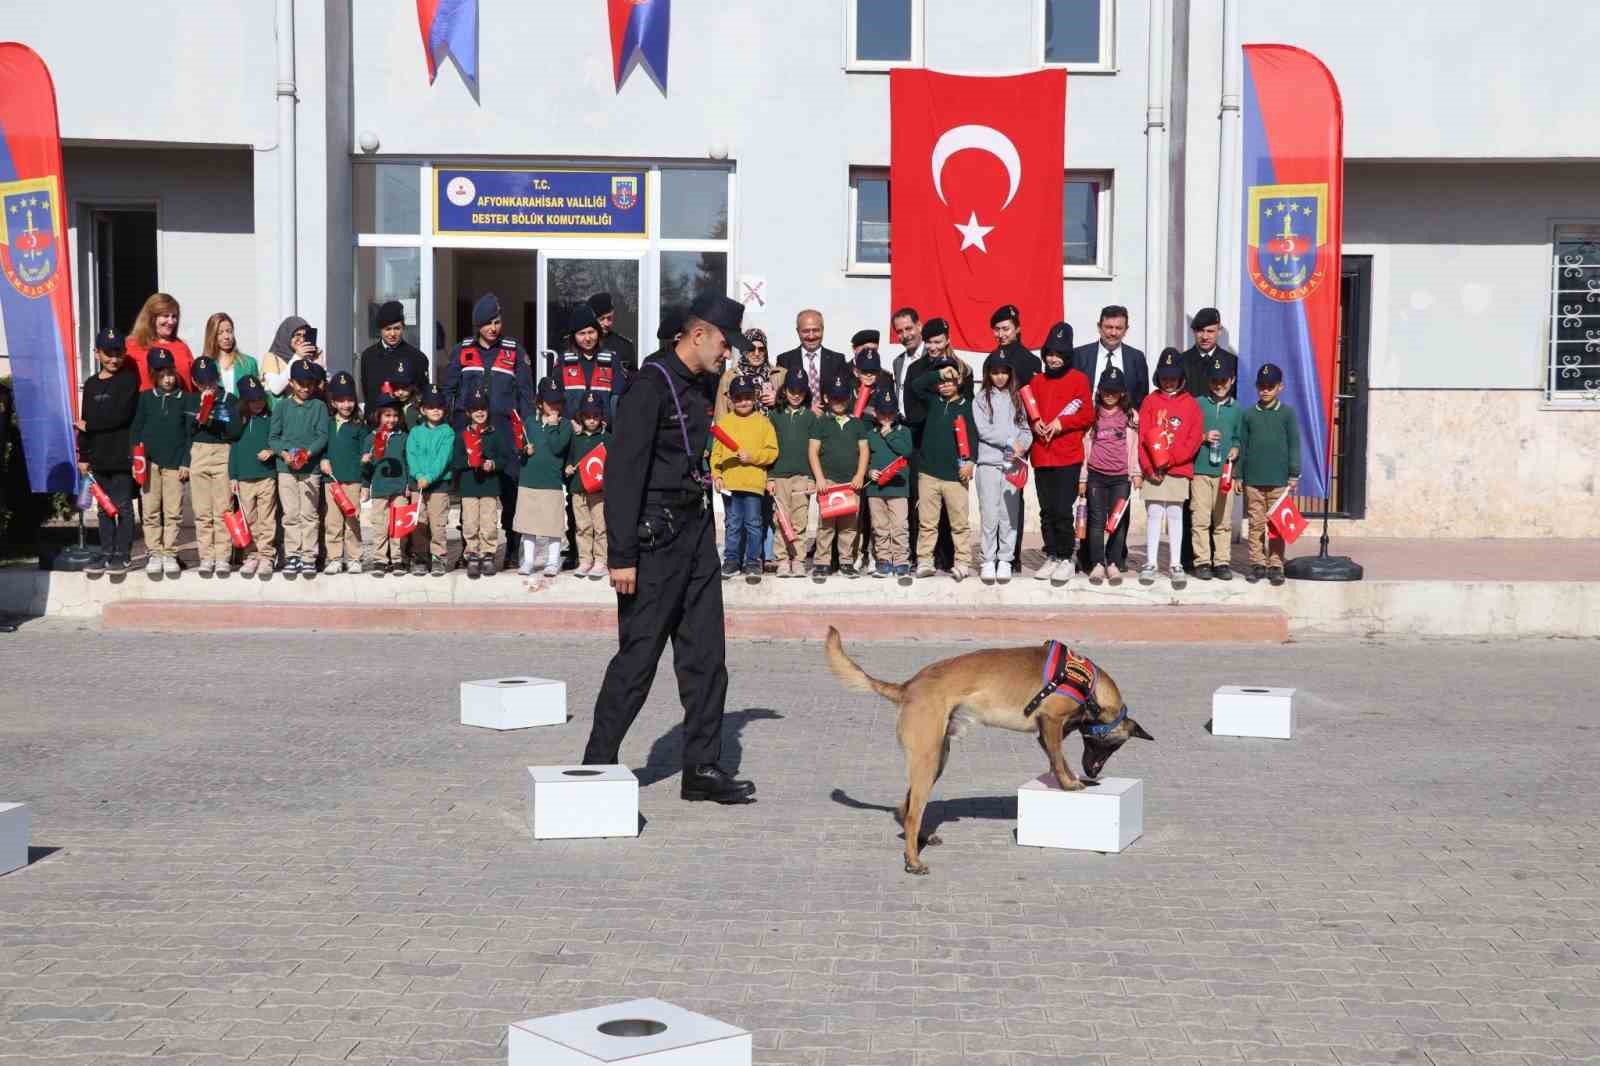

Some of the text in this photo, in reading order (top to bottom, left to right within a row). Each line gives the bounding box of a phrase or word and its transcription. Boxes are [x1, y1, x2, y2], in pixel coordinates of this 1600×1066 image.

[533, 179, 551, 191] T.C.
[477, 194, 563, 208] AFYONKARAHİSAR
[565, 195, 606, 208] VALİLİĞİ
[472, 212, 612, 226] DESTEK BÖLÜK KOMUTANLIĞI
